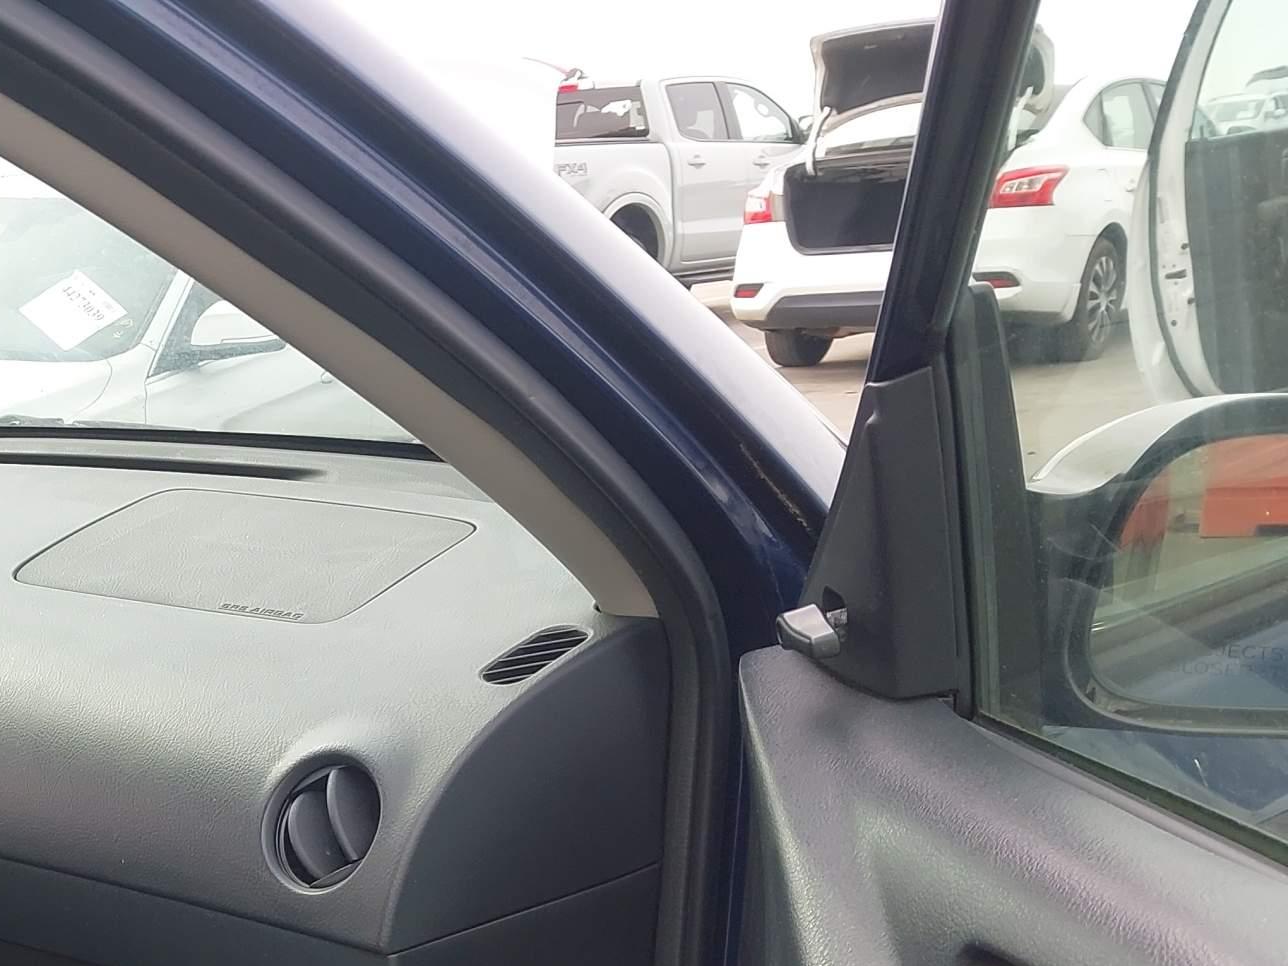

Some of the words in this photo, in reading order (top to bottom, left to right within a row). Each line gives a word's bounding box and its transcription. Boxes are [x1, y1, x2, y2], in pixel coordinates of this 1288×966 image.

[554, 162, 588, 176] FX4
[221, 603, 249, 611] SRS
[250, 607, 304, 620] AIRBAG
